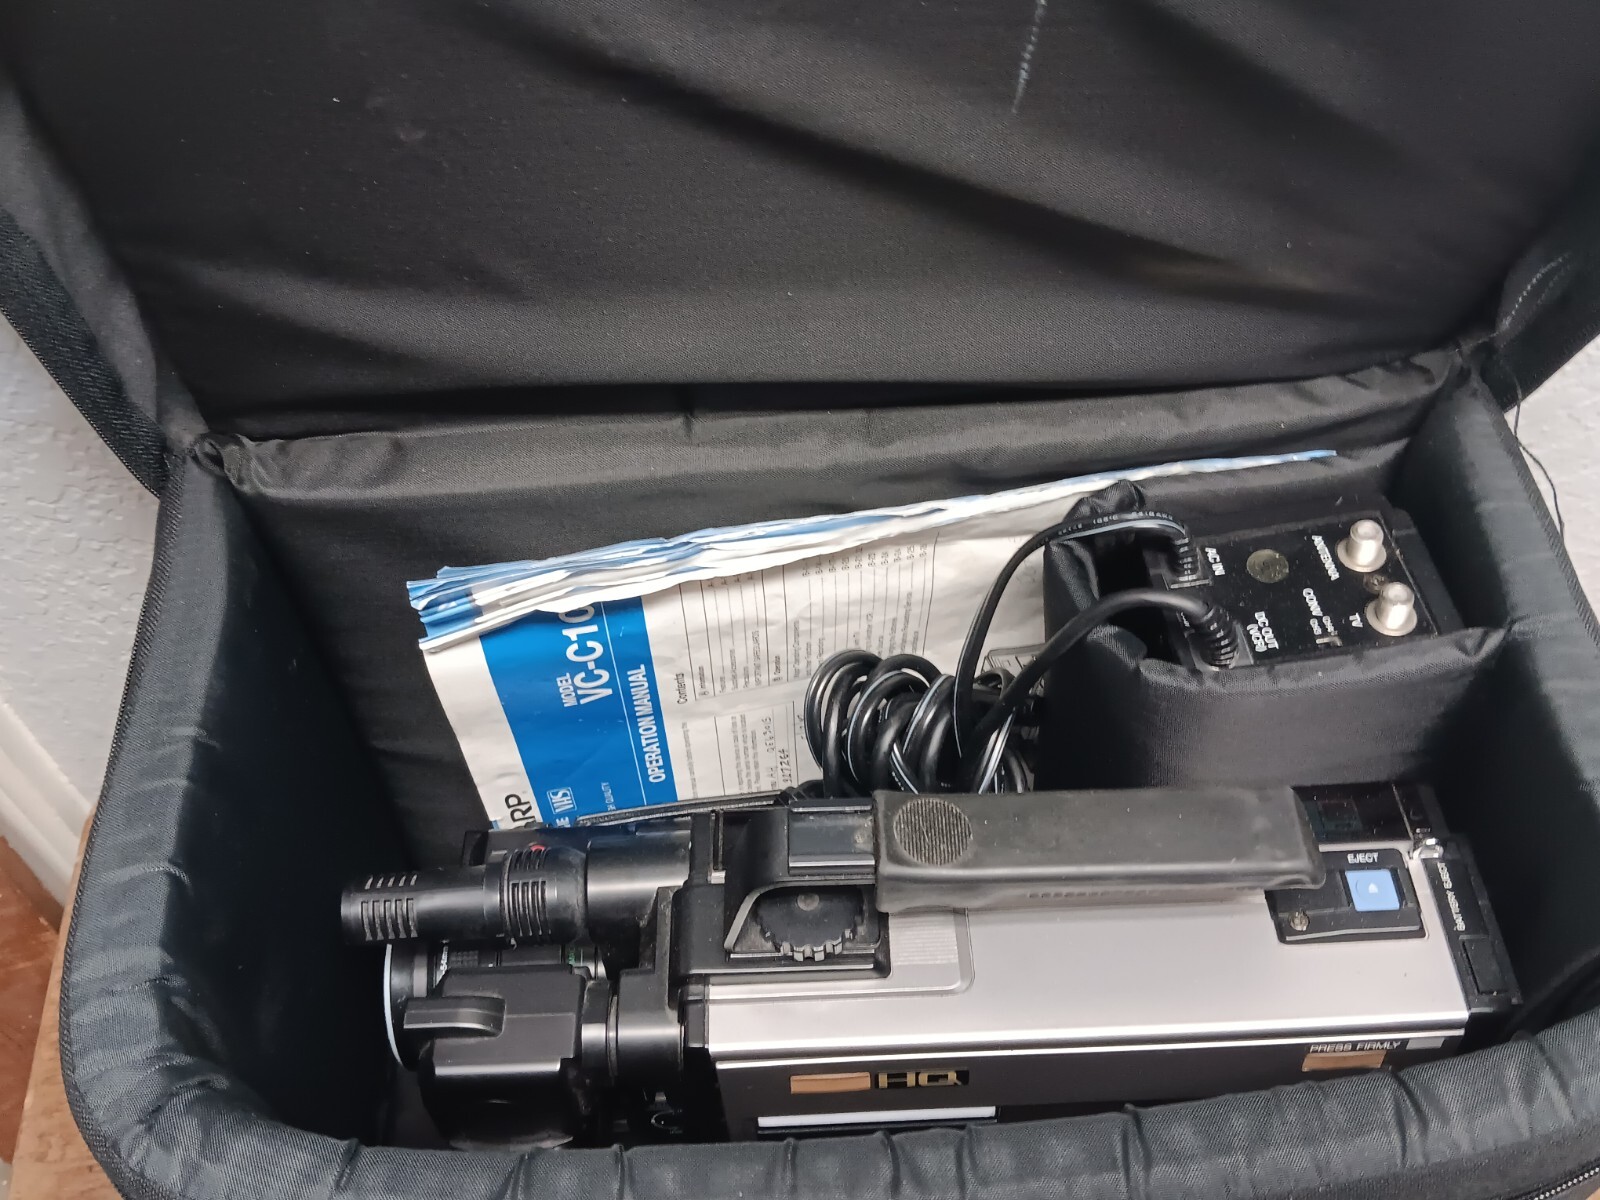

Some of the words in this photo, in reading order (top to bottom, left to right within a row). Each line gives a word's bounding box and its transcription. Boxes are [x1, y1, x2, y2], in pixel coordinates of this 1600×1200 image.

[1205, 547, 1220, 563] AC
[1213, 563, 1225, 576] IN
[1312, 535, 1339, 581] ANTENNA
[1302, 588, 1322, 617] CONV
[1255, 611, 1269, 627] DC
[1349, 613, 1363, 628] TV
[1260, 627, 1279, 649] OUT
[557, 673, 578, 707] MODEL
[628, 664, 652, 715] MANUAL
[674, 673, 687, 704] Contents
[637, 715, 666, 783] OPERATION
[549, 790, 574, 812] VHS
[1347, 852, 1378, 864] EJECT
[1437, 861, 1453, 889] EJECT
[1446, 890, 1465, 931] BATTERY
[1309, 1043, 1354, 1053] PRESS
[1356, 1040, 1401, 1051] FIRMLY
[878, 1070, 963, 1089] HQ
